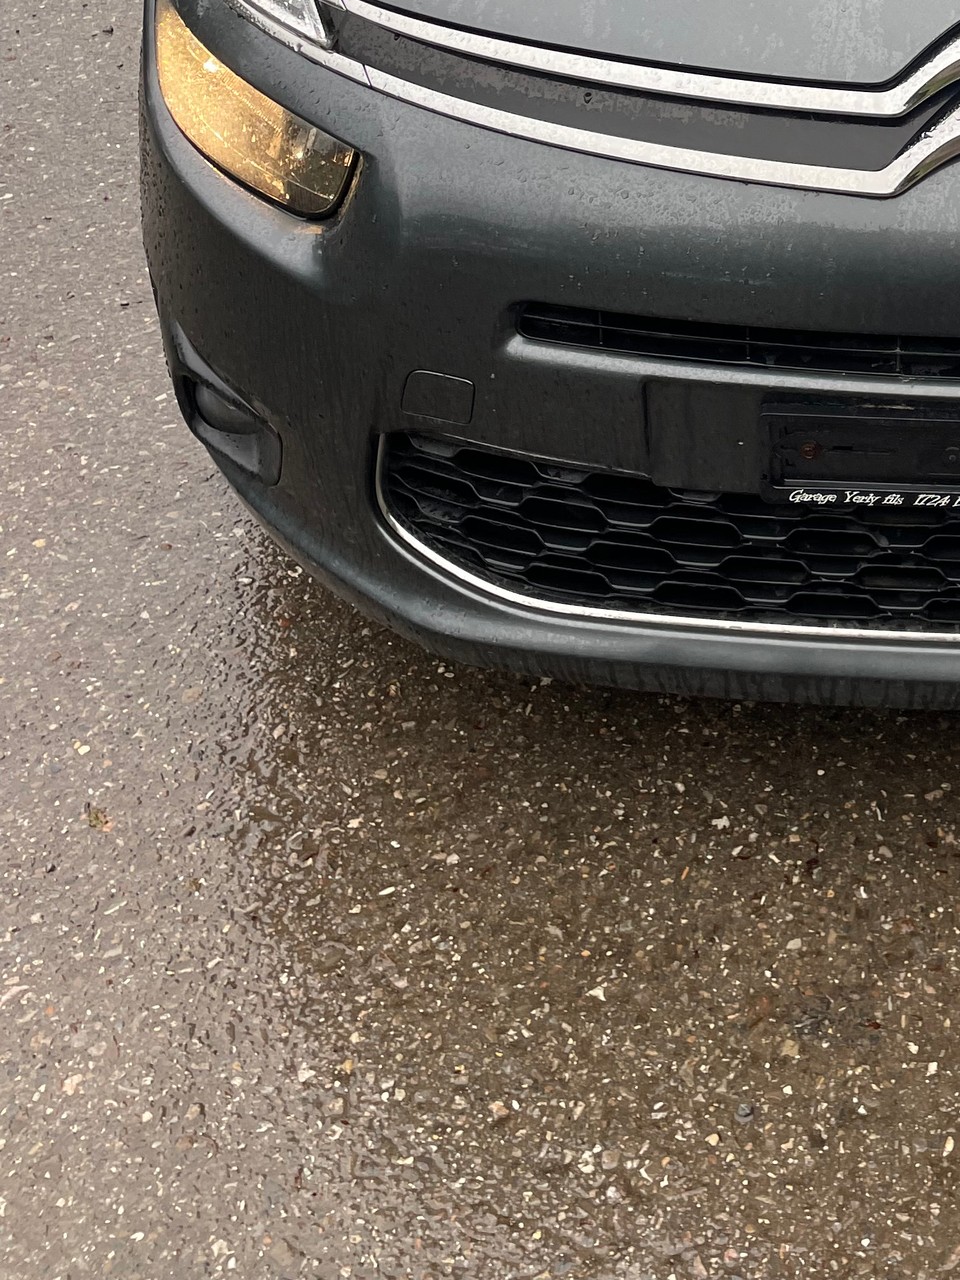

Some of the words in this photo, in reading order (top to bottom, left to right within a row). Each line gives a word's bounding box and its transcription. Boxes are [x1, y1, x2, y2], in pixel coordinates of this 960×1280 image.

[789, 489, 837, 504] Garage
[844, 491, 881, 506] Yerly
[882, 494, 905, 506] fils
[913, 494, 951, 507] 1724
